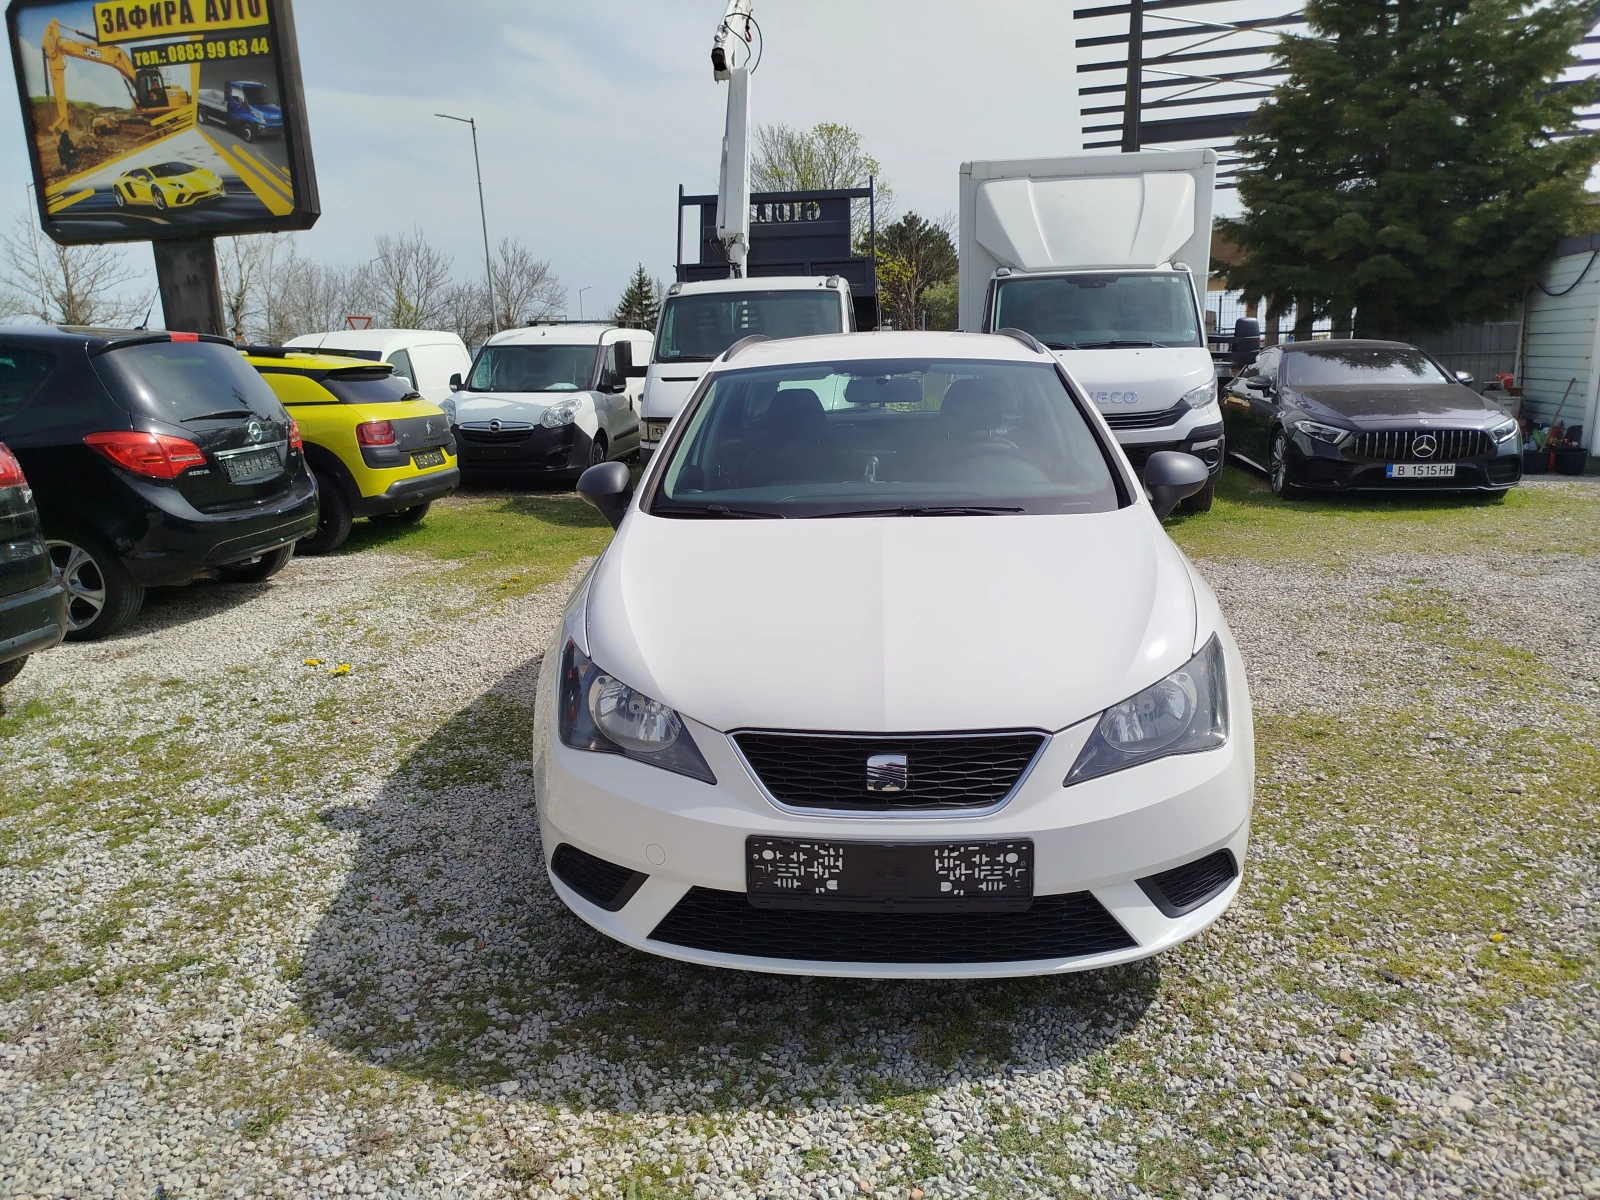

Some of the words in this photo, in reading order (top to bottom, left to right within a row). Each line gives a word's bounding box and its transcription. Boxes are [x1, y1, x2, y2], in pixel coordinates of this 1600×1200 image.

[101, 0, 194, 34] ЗАФИРА
[205, 0, 262, 22] АУТО
[83, 47, 102, 59] JCB
[134, 51, 167, 66] тел.:
[168, 43, 204, 63] 0883
[207, 40, 226, 59] 99
[229, 39, 248, 57] 83
[251, 37, 269, 55] 44
[1089, 391, 1138, 404] ECO
